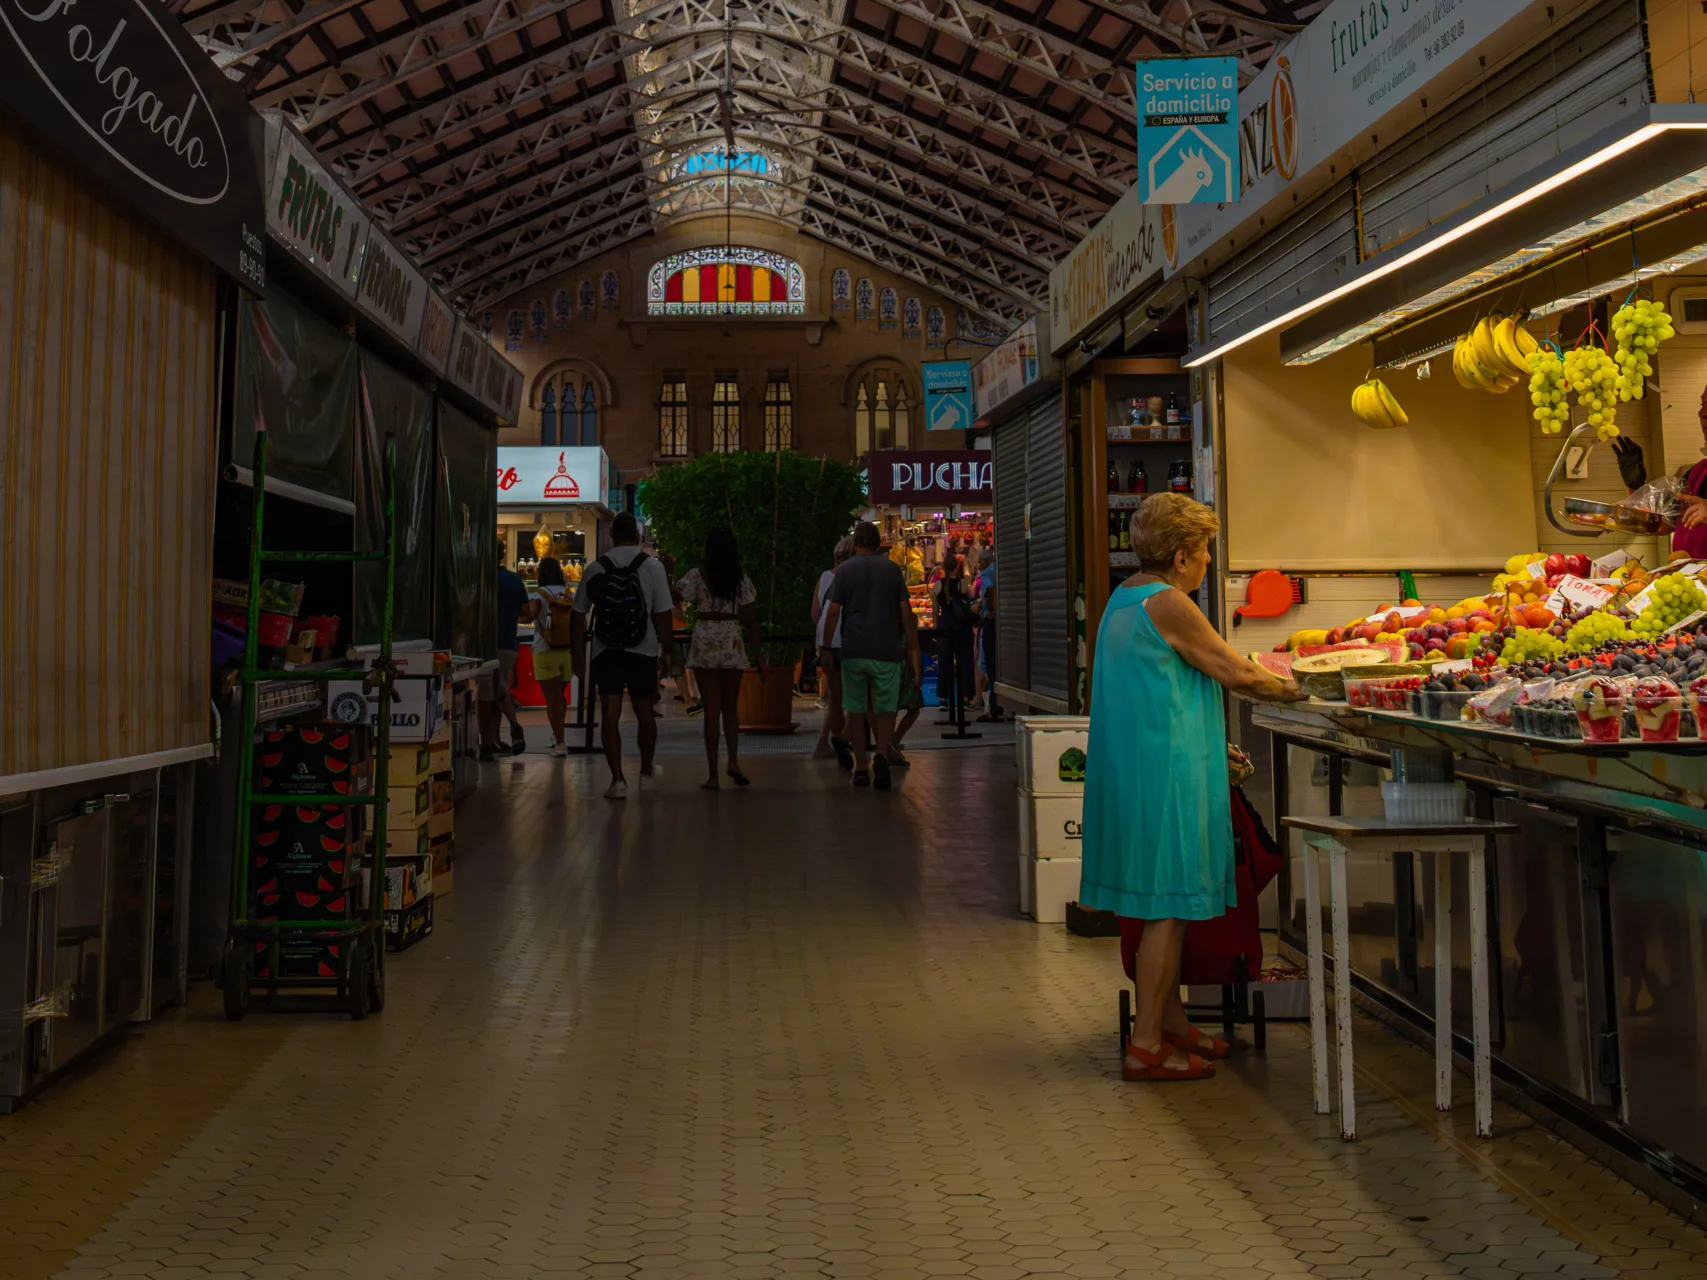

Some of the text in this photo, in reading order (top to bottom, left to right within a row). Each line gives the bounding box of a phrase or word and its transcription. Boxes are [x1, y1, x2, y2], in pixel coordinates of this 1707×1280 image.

[1142, 72, 1232, 95] Servicio a
[1145, 93, 1231, 114] domicilio
[1163, 114, 1188, 125] ESPAÑA
[1194, 115, 1220, 124] EUROPA
[278, 154, 343, 263] FRUTAS
[242, 223, 263, 255] Puestos
[239, 250, 265, 288] 89-90-91
[1069, 232, 1107, 334] CERVEZAS
[1108, 204, 1155, 299] mercado
[891, 461, 993, 491] PUCHA
[371, 713, 420, 727] BLLO
